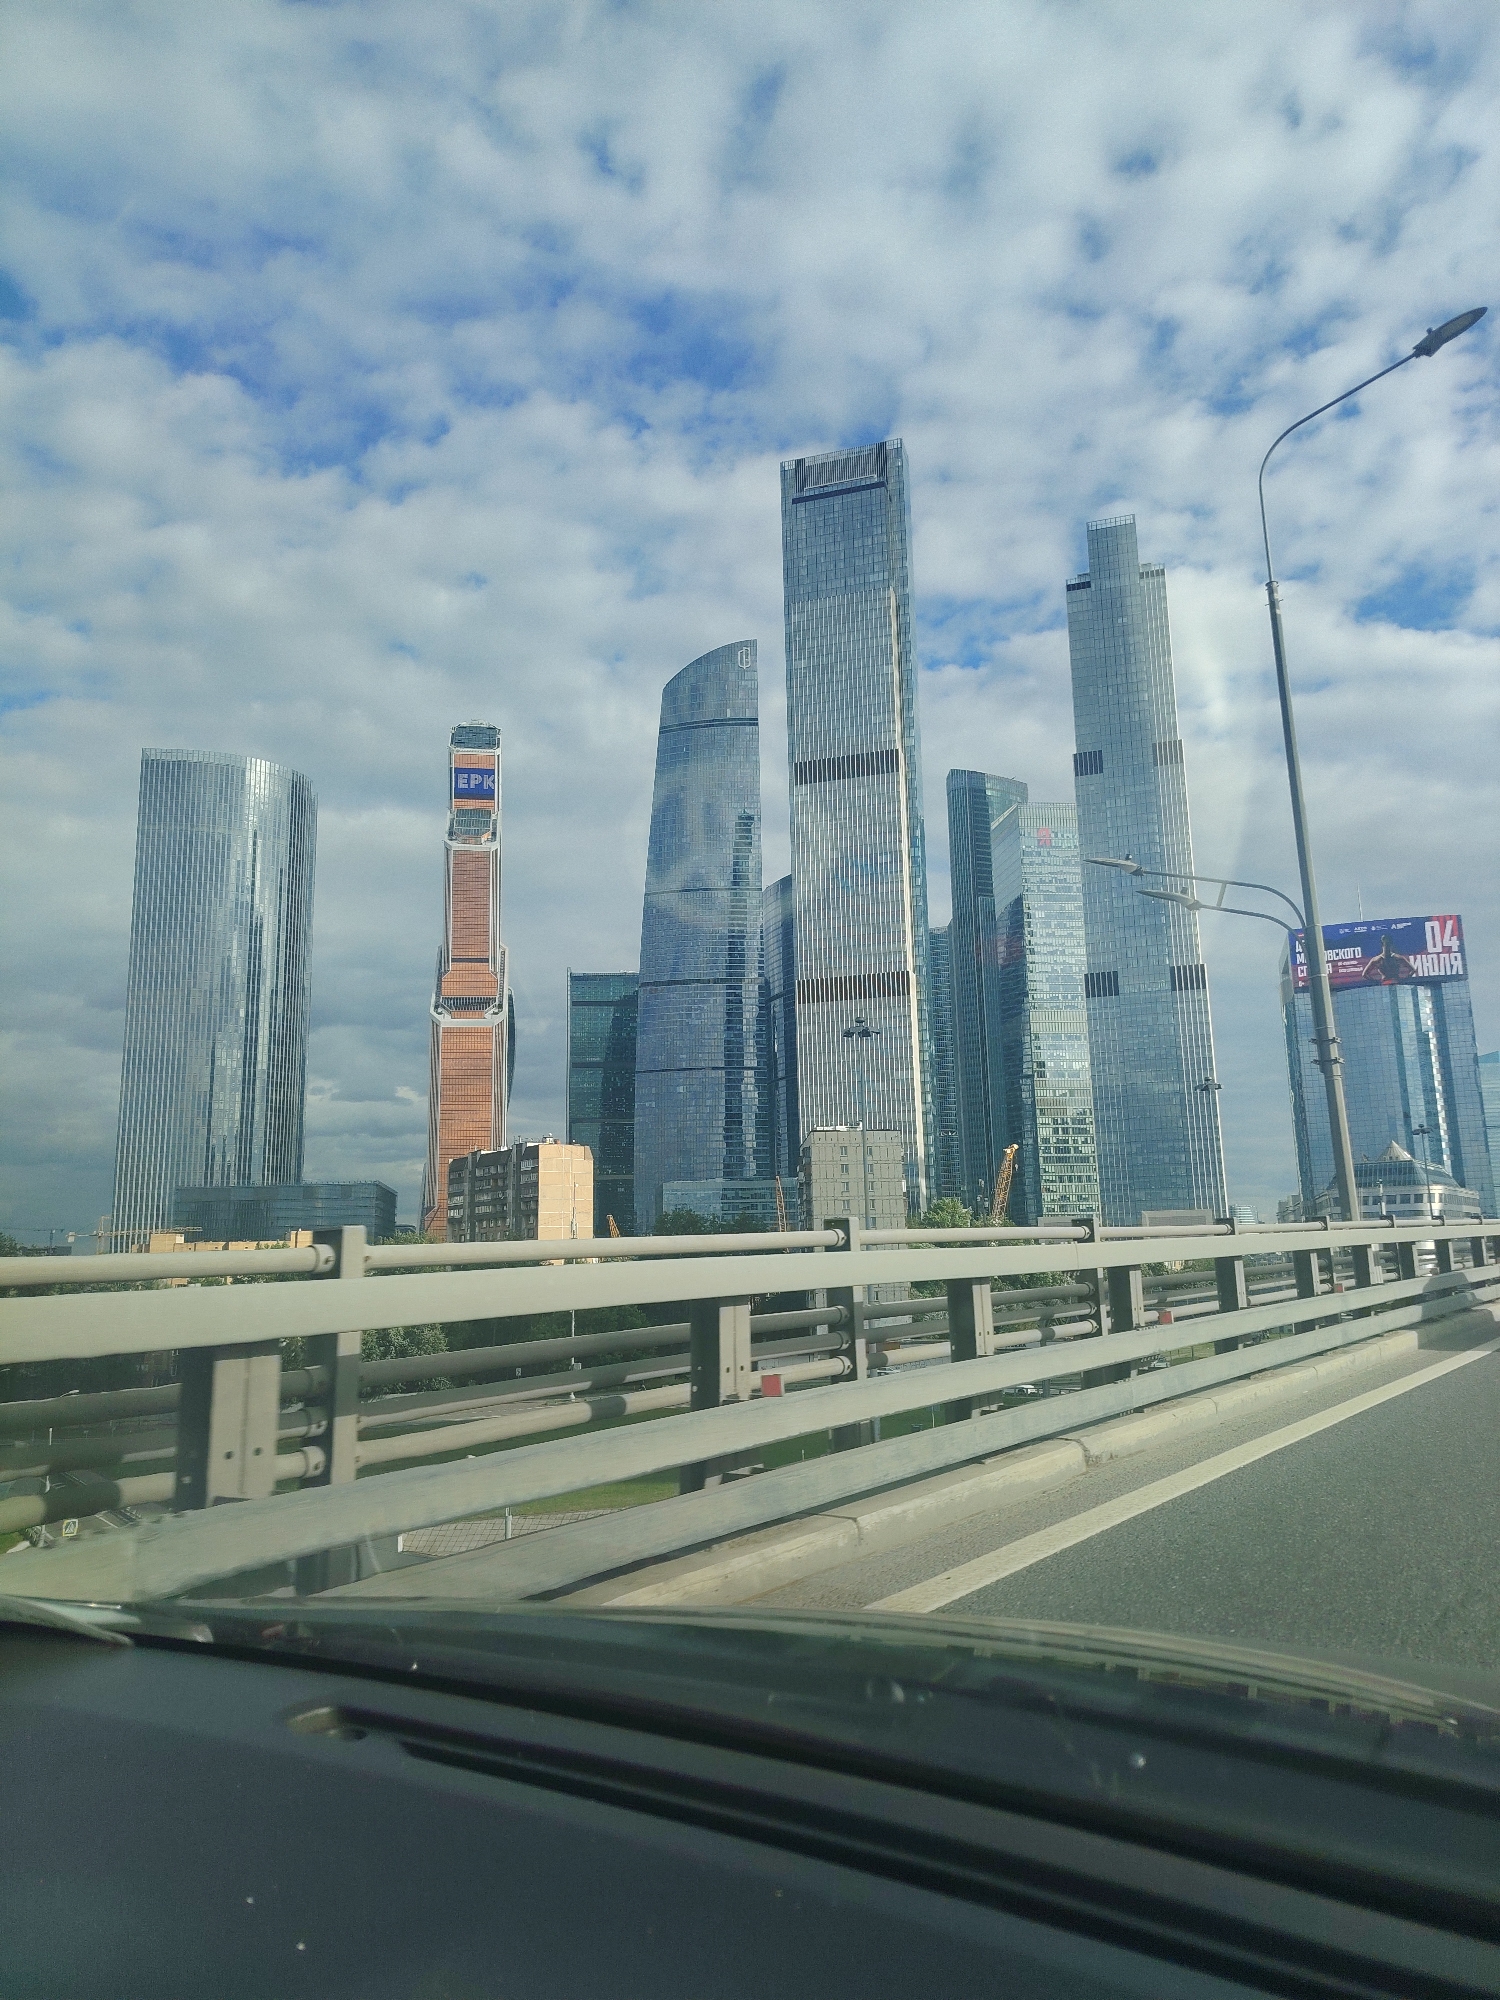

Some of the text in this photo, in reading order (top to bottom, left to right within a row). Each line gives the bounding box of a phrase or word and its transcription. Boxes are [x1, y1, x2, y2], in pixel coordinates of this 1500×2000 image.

[1425, 919, 1460, 953] 04
[1296, 946, 1362, 965] МВСКОГО
[1408, 952, 1464, 978] ИЮЛЯ
